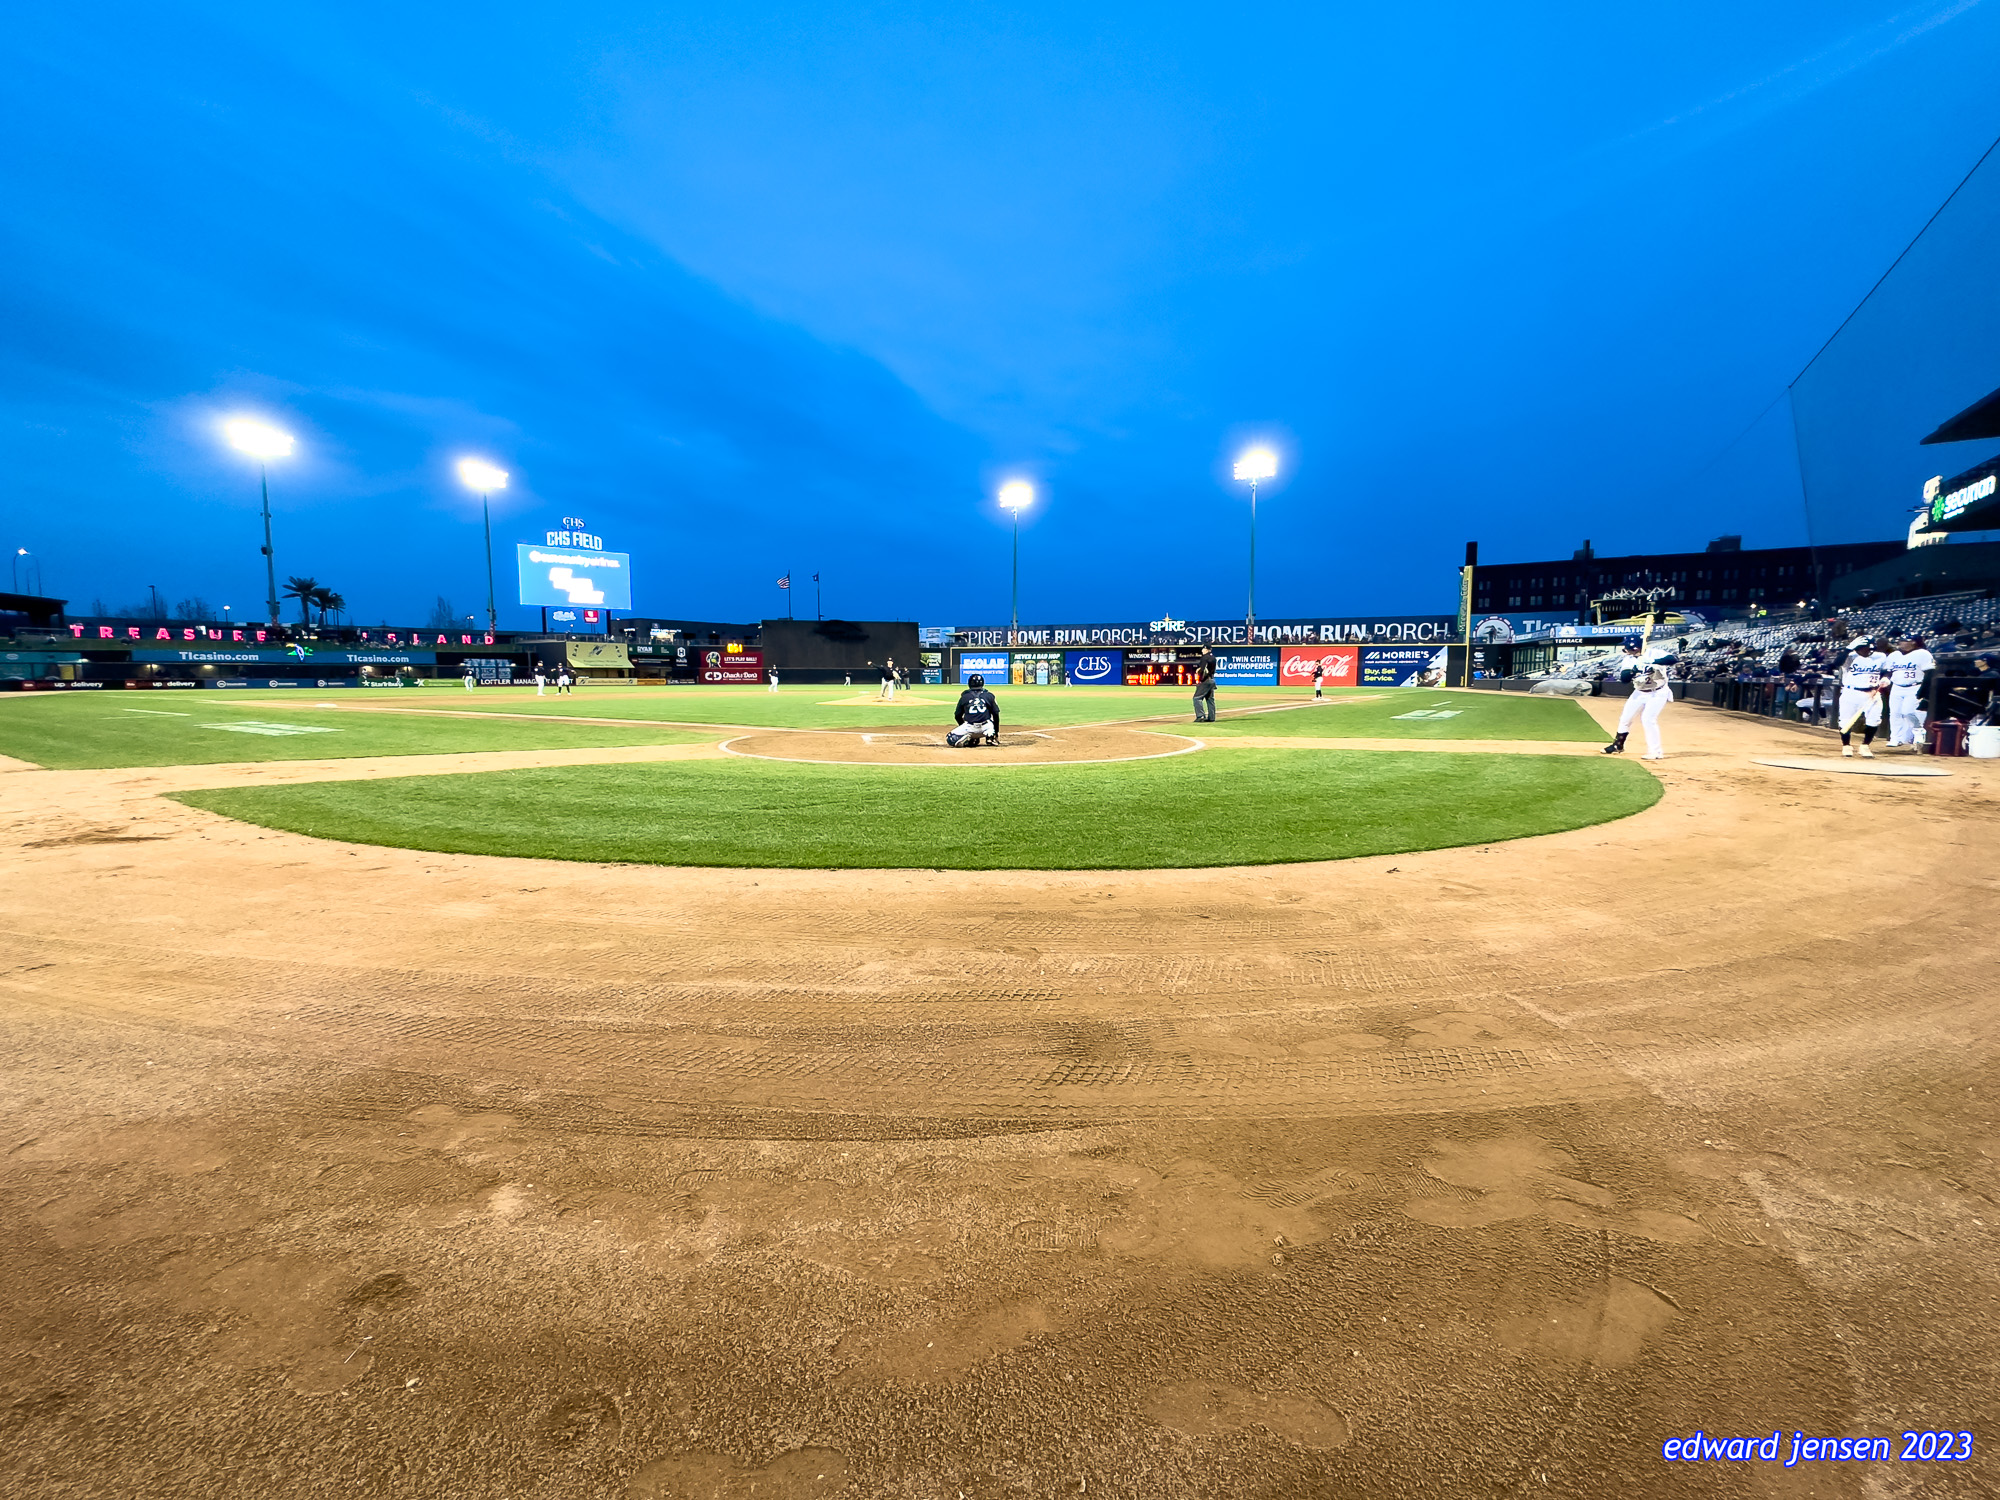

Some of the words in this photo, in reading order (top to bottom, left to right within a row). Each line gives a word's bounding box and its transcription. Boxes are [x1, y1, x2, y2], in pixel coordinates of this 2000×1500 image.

[547, 532, 571, 546] CHS
[573, 533, 603, 551] FIELD
[1150, 620, 1185, 632] SPIRE
[1007, 630, 1050, 646] HOME
[1055, 629, 1087, 645] RUN
[1091, 628, 1143, 645] PORCH
[1185, 626, 1246, 643] SPIRE
[1253, 625, 1314, 643] HOME
[1320, 624, 1367, 642] RUN
[1374, 623, 1449, 642] PORCH
[1383, 650, 1430, 660] MORRIE'S
[963, 658, 1005, 669] ECOLAB
[1079, 656, 1109, 671] CHS
[1283, 654, 1354, 679] CocaCola
[1364, 668, 1381, 676] Buy.
[71, 681, 103, 689] delivery
[167, 681, 196, 689] delivery
[371, 680, 405, 688] StarTribue
